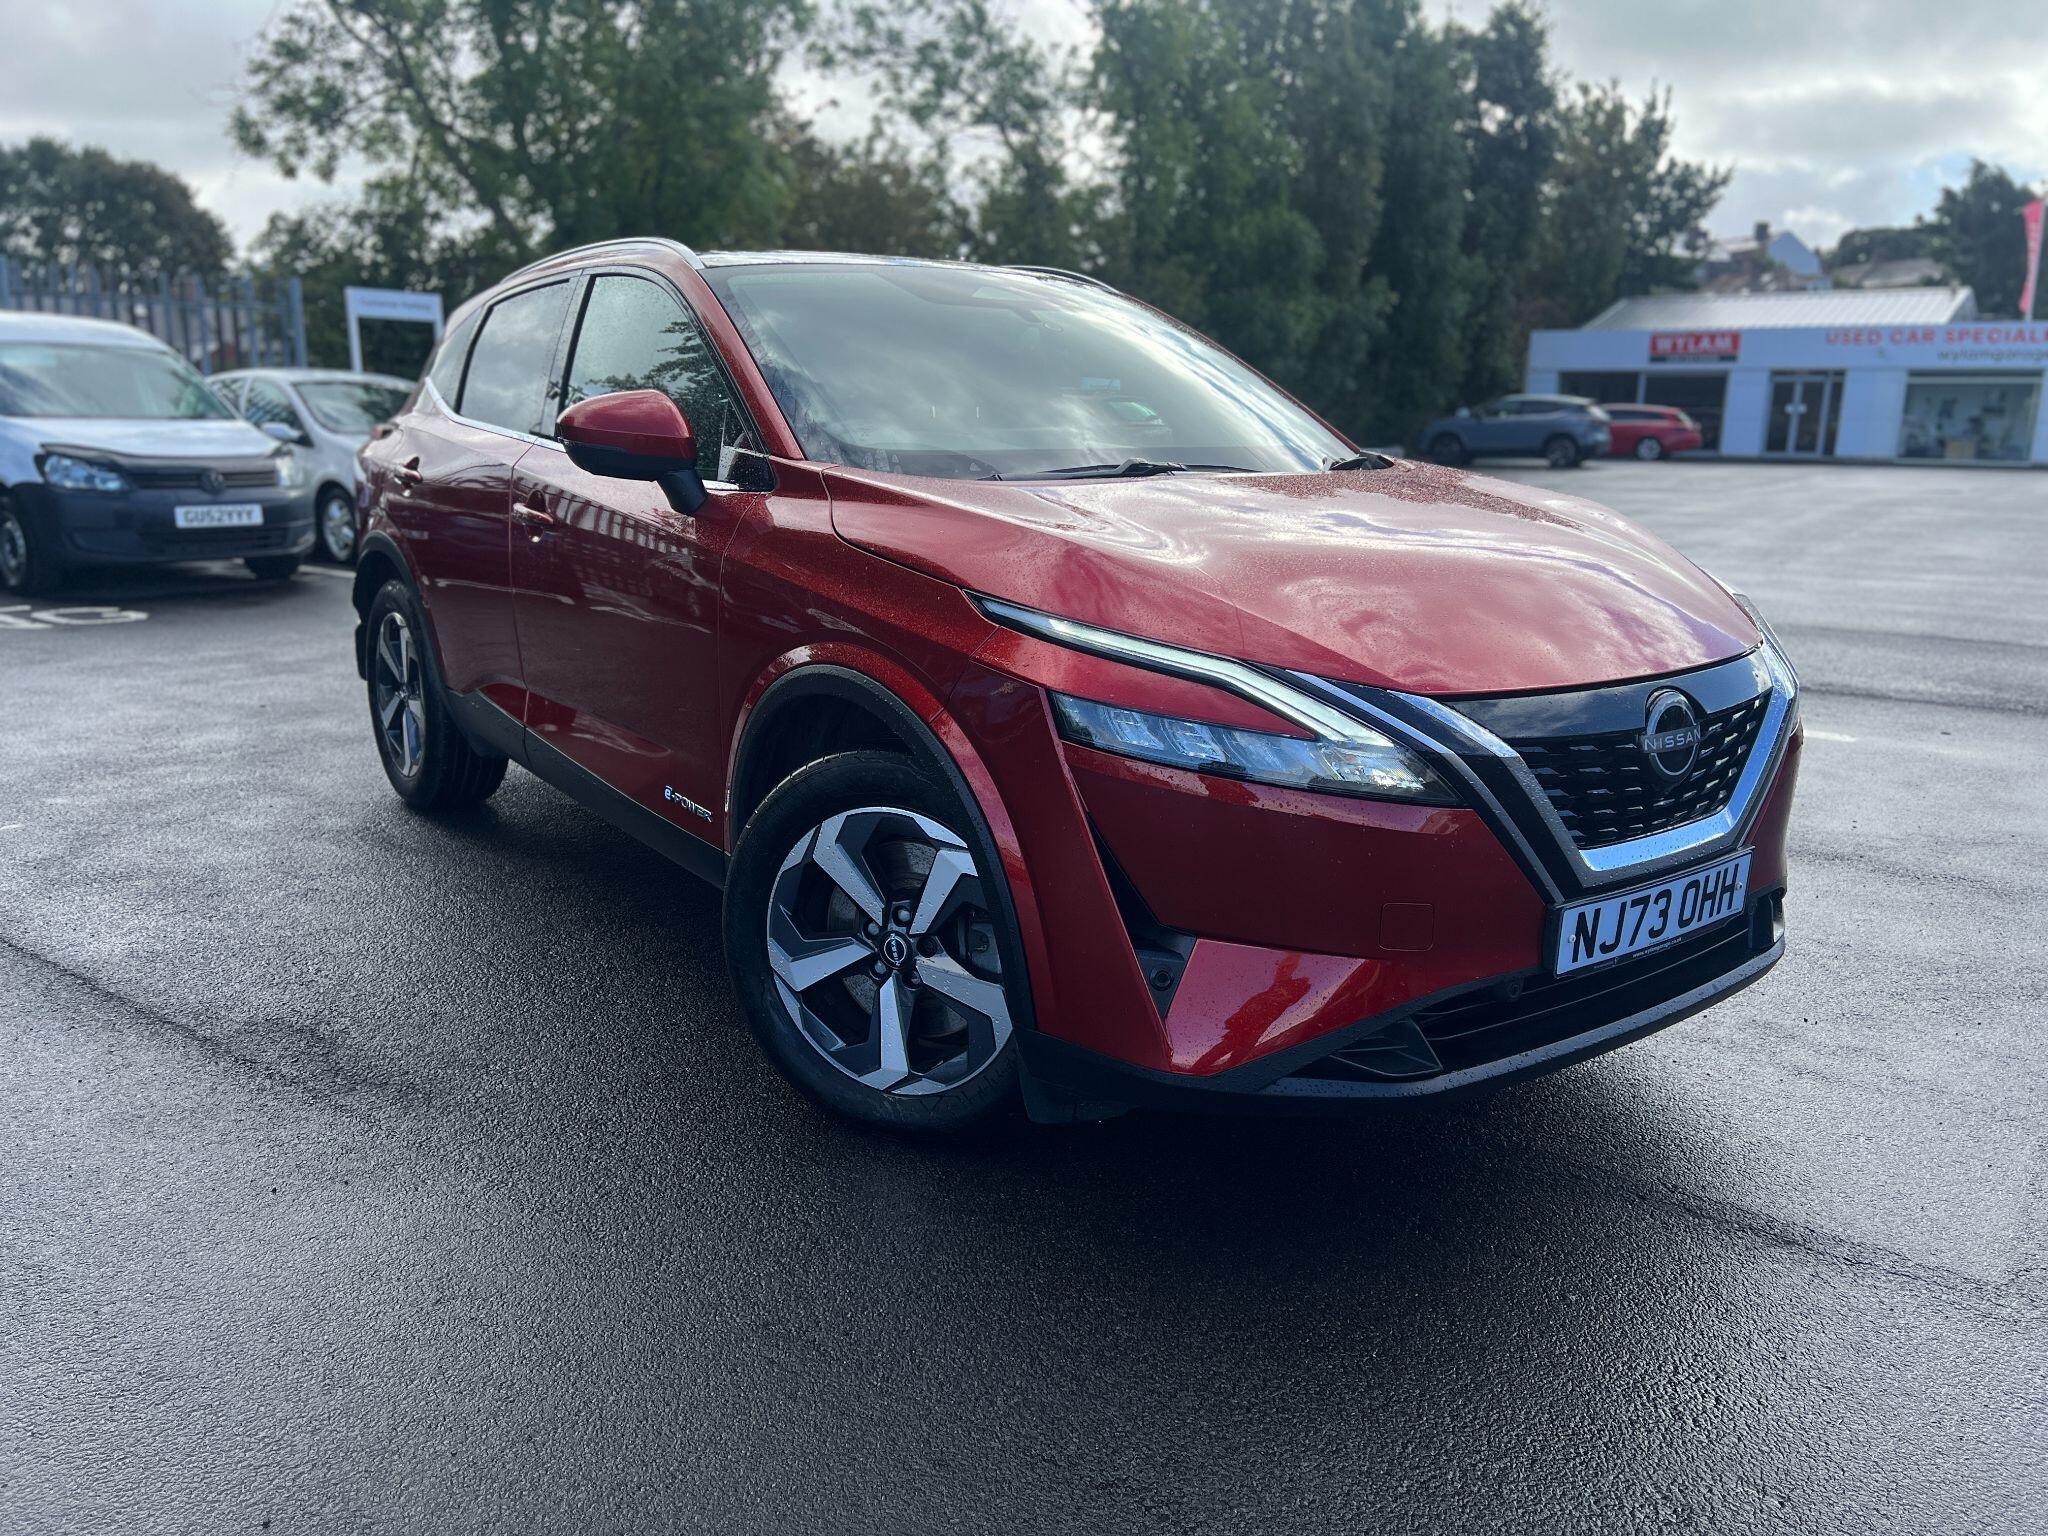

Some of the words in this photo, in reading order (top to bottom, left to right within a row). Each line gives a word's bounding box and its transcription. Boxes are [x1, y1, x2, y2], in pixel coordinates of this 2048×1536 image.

[1656, 334, 1732, 352] WYLAM
[1825, 327, 1882, 346] USED
[1889, 327, 1936, 345] CAR
[1644, 722, 1701, 751] NISSAN
[1571, 888, 1673, 964] NJ73
[1677, 863, 1740, 930] OHH
[889, 932, 901, 967] NISSAN
